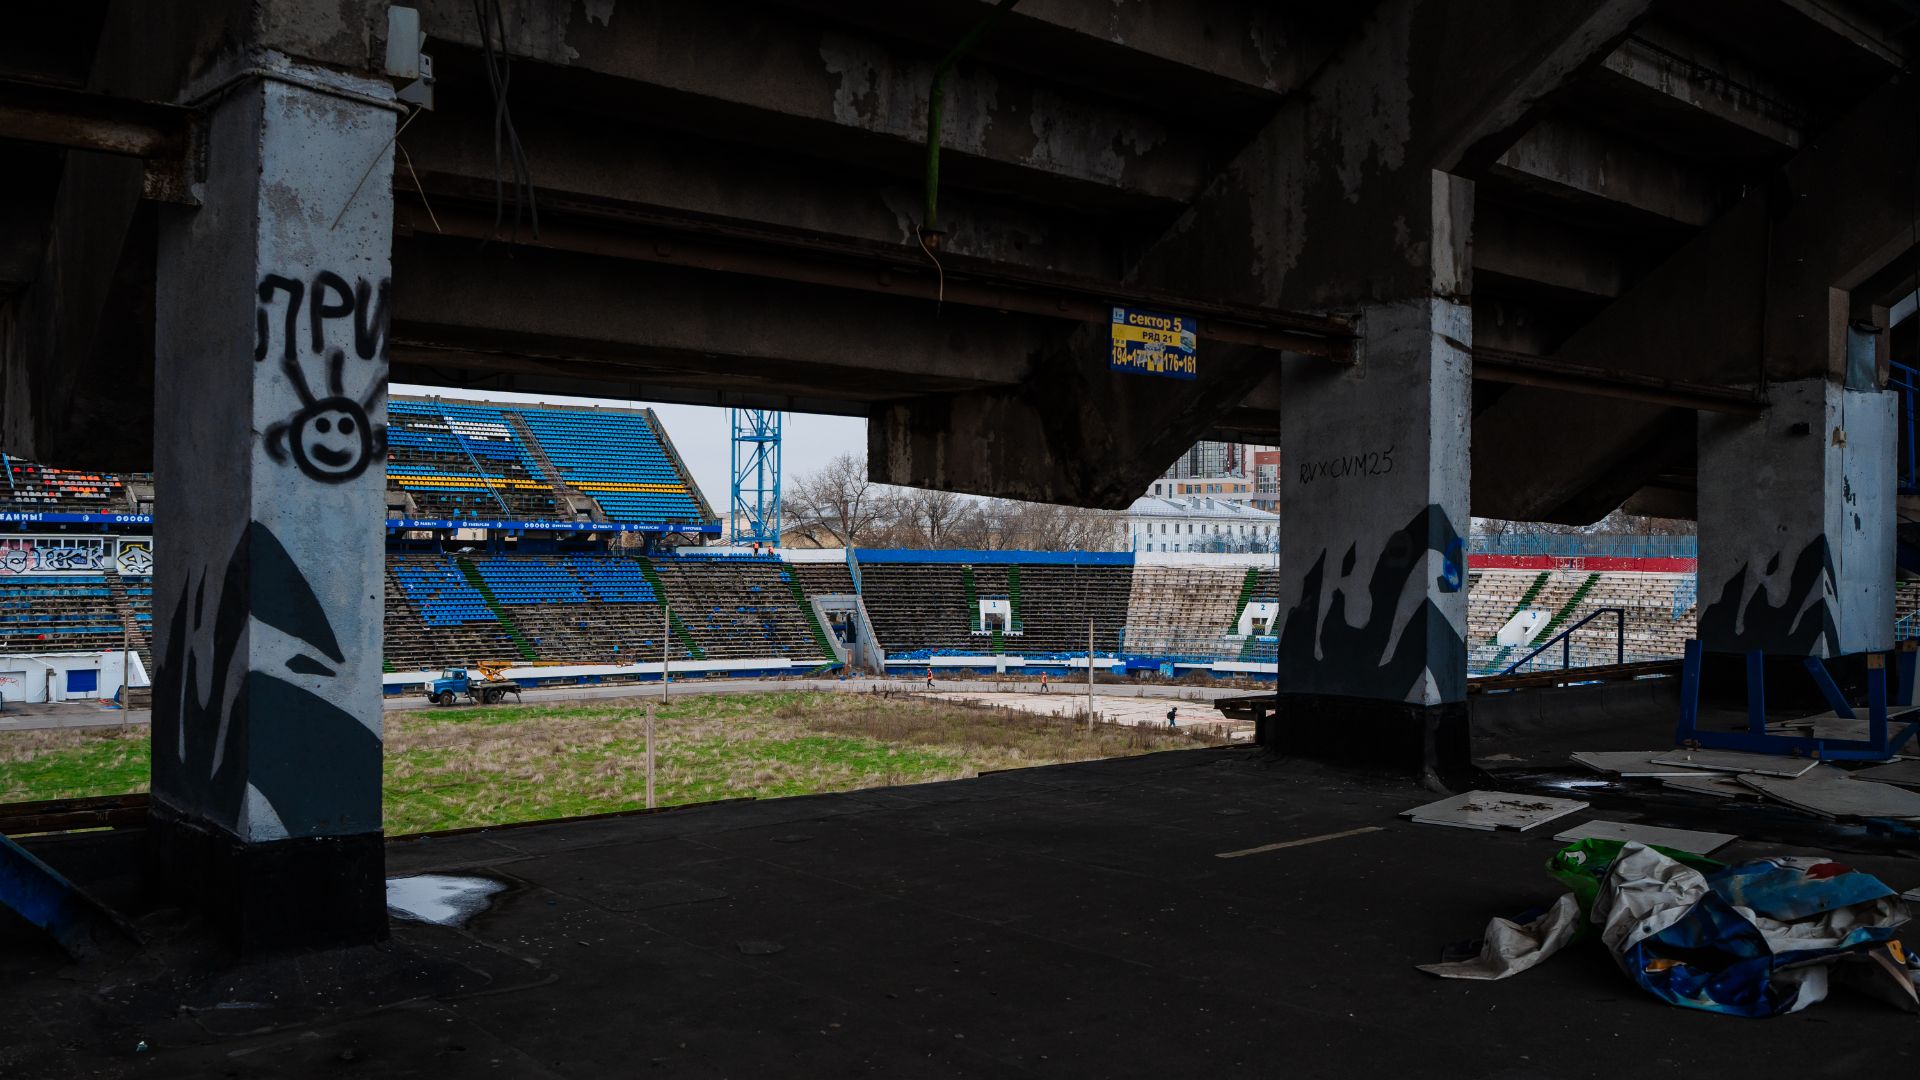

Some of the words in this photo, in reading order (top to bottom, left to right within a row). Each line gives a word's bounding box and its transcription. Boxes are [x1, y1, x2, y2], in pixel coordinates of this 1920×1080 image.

[1129, 313, 1172, 331] сектор
[1173, 317, 1182, 332] 5
[1142, 331, 1160, 342] РЯД
[1162, 335, 1173, 343] 21
